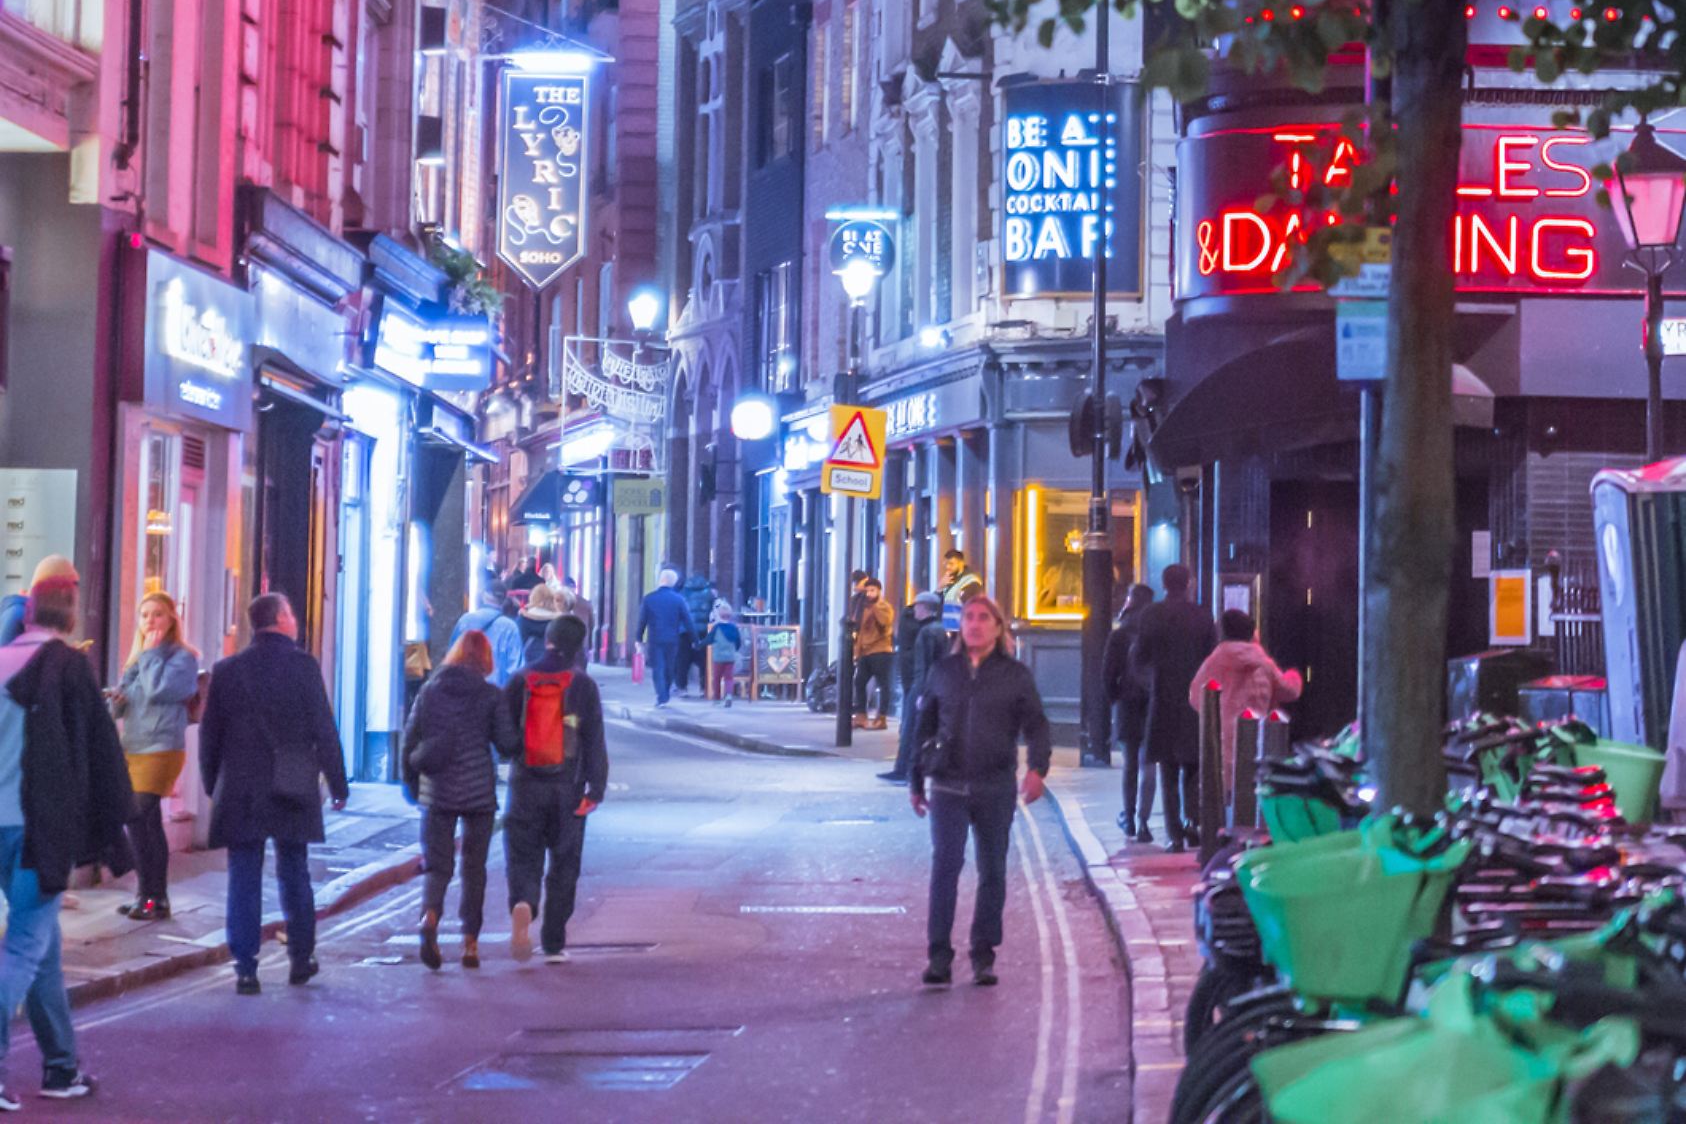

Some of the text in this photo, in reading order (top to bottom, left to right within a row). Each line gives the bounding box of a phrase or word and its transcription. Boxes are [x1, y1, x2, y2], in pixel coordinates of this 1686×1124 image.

[533, 85, 581, 104] THE
[1007, 117, 1047, 149] BE
[1006, 192, 1114, 215] COCKTAI
[519, 251, 562, 264] SOHO
[834, 473, 868, 486] School
